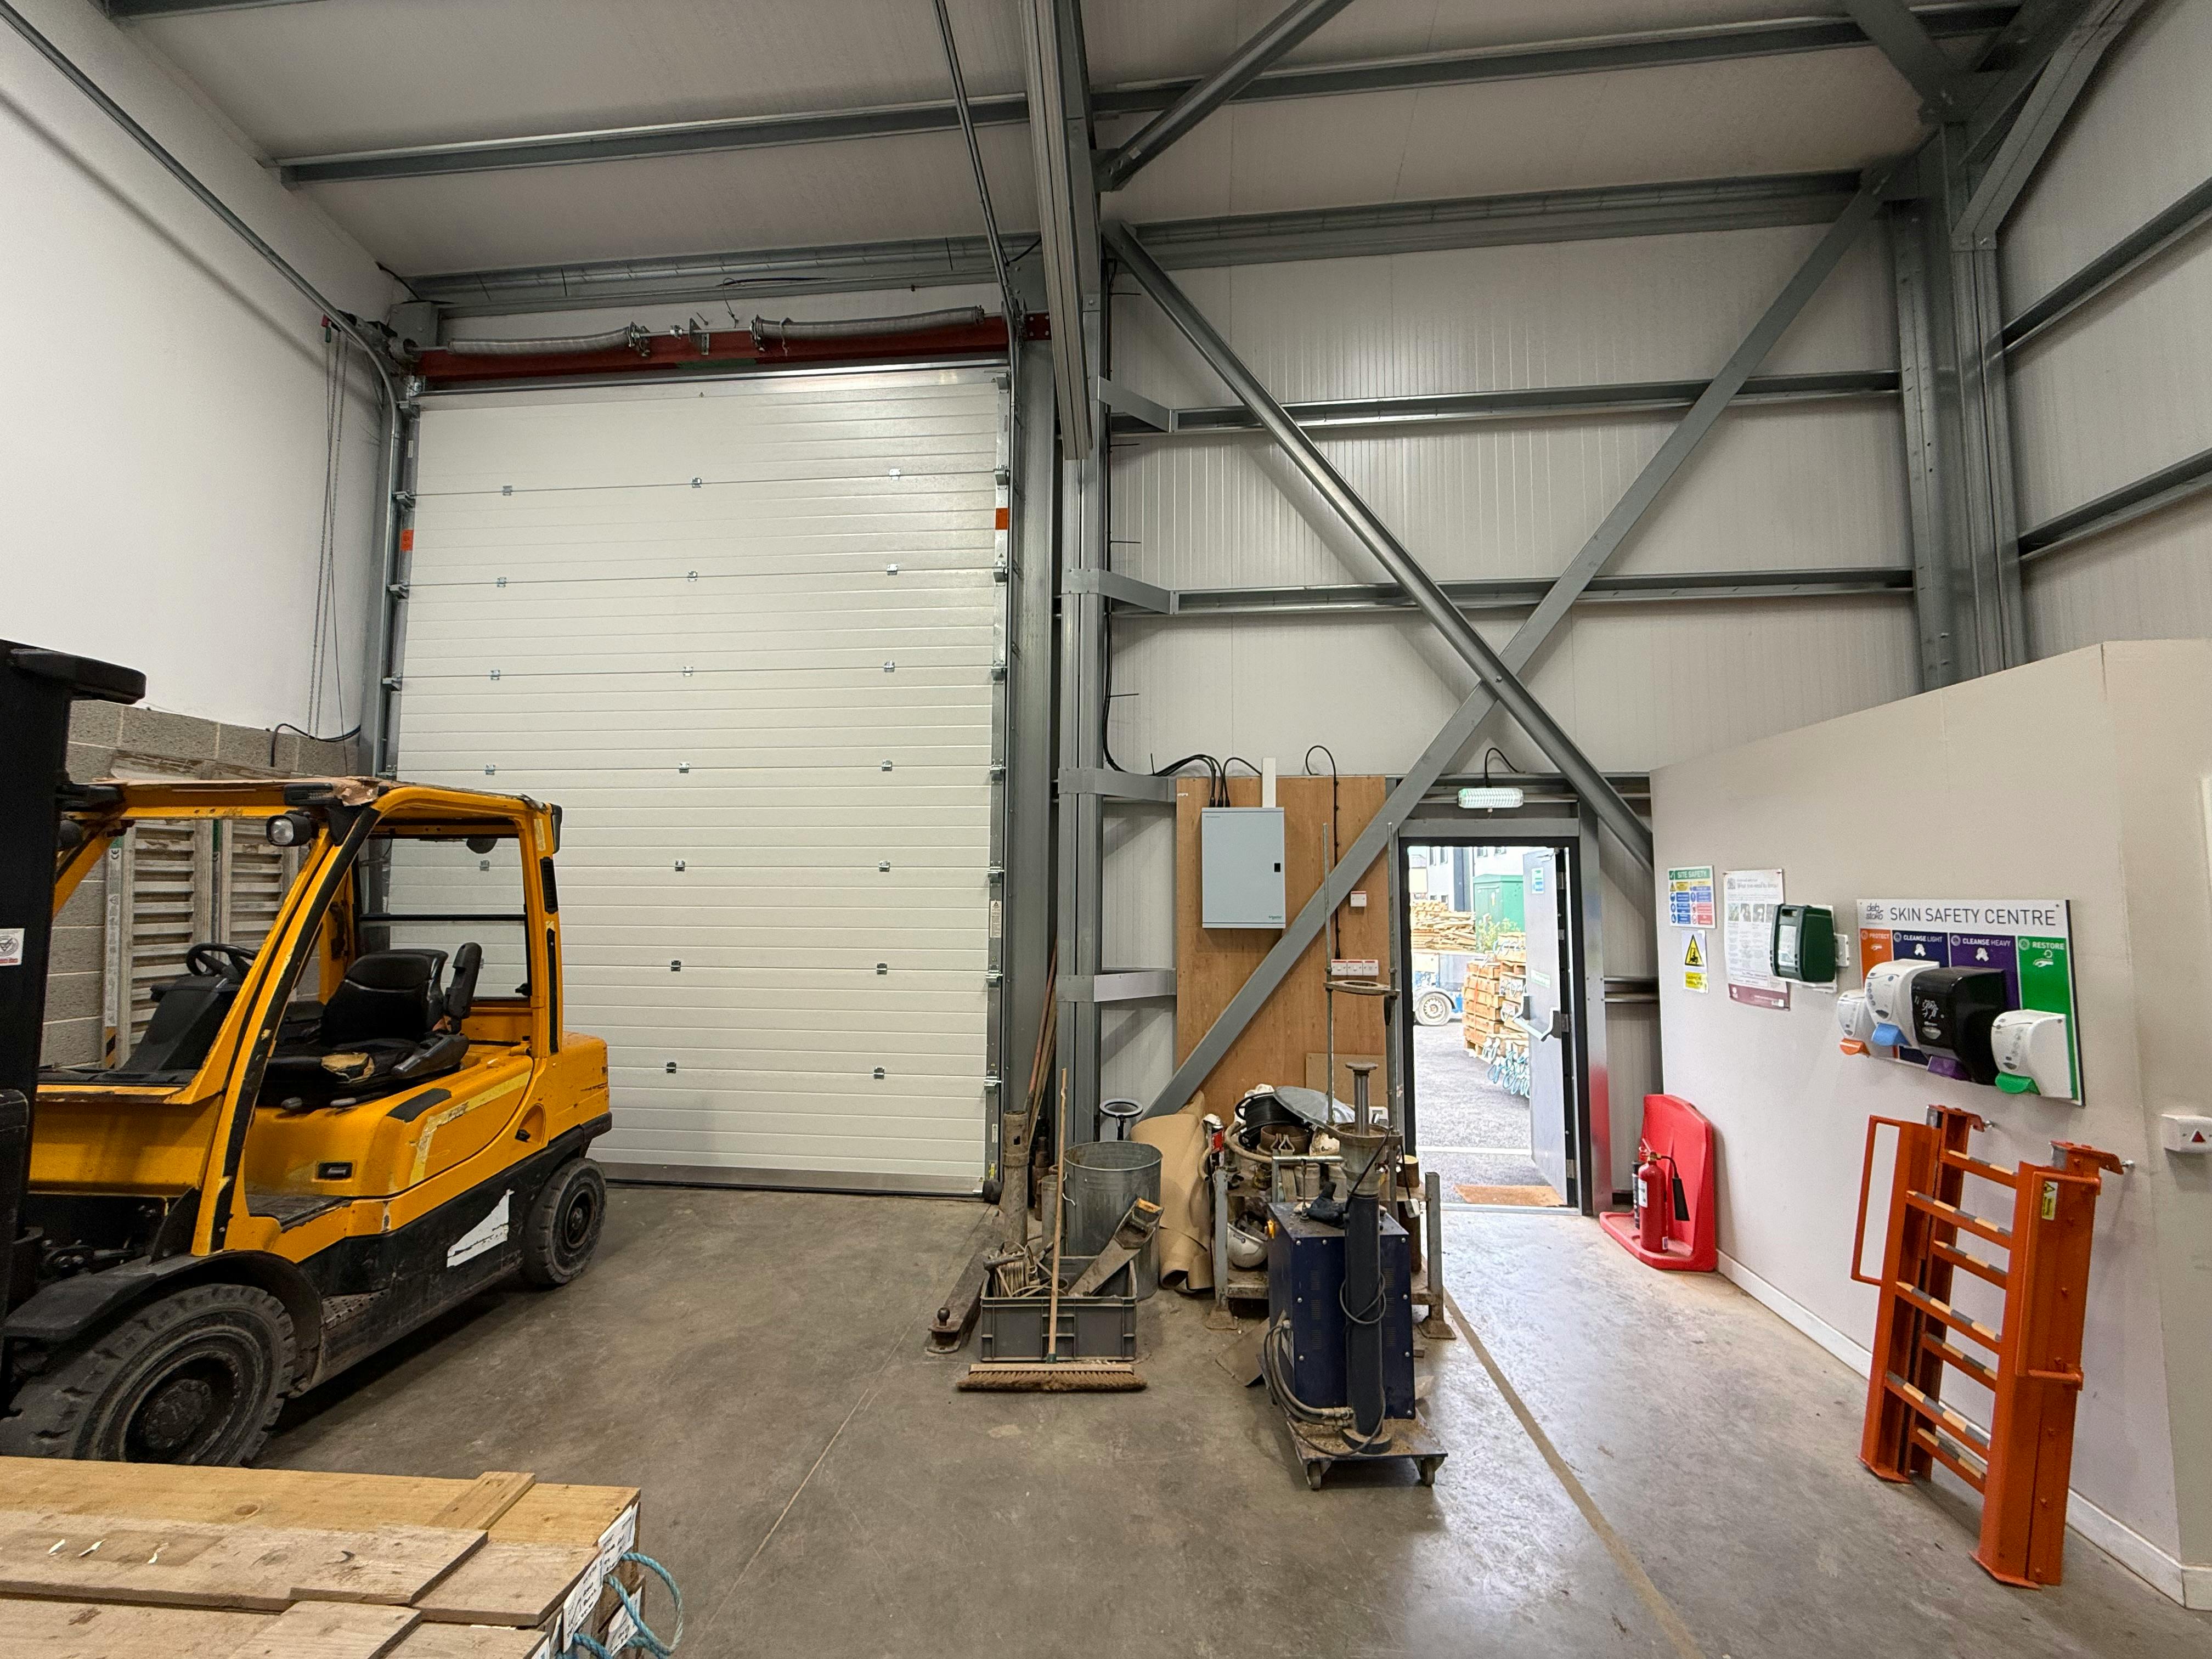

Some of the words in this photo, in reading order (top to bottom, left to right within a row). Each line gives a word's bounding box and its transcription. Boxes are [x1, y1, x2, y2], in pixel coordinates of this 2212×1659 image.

[1866, 902, 1880, 912] deb
[1890, 907, 1920, 922] SKIN
[1925, 908, 1979, 923] SAFETY
[1985, 909, 2056, 926] CENTRE
[1962, 938, 1990, 946] CLEANSE
[2032, 941, 2064, 950] RESTORE
